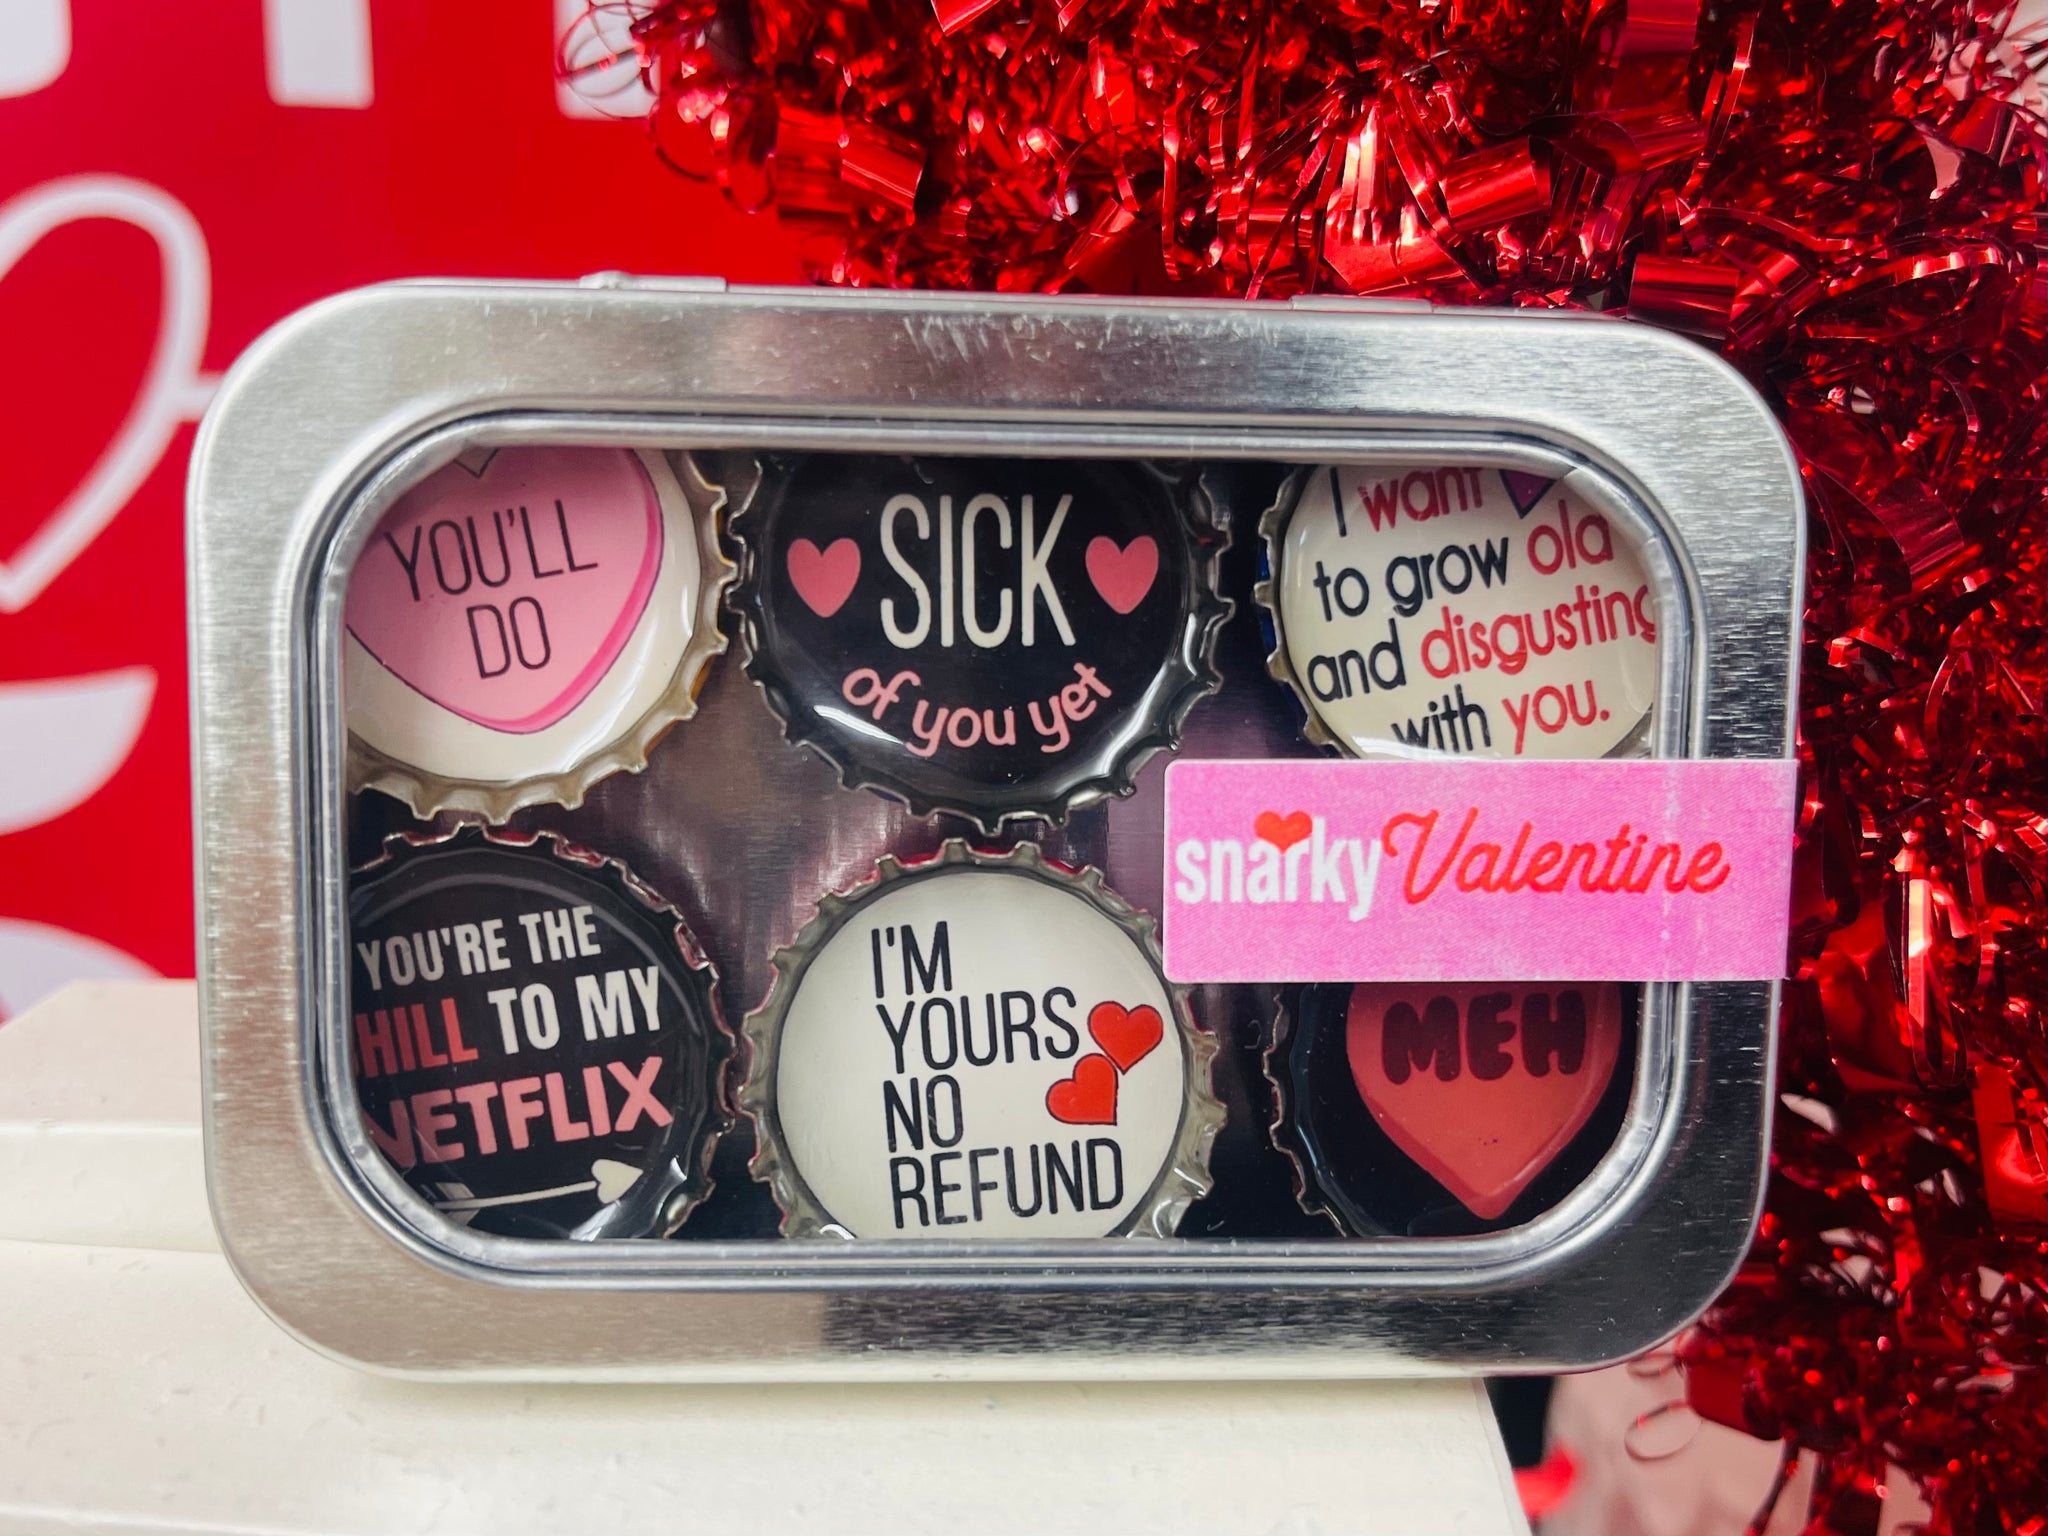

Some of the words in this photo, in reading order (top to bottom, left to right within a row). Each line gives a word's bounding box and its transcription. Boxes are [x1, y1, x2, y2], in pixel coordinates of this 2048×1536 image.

[1330, 467, 1347, 537] I
[384, 500, 598, 601] YOU'LL
[880, 493, 1076, 648] SICK
[1313, 561, 1369, 621] to
[1386, 536, 1509, 617] grow
[467, 597, 551, 678] DO
[1307, 617, 1407, 702] and
[842, 667, 922, 720] of
[904, 700, 1016, 758] you
[1027, 662, 1112, 753] yet
[1391, 684, 1491, 753] with
[1502, 680, 1609, 755] you.
[1175, 815, 1383, 922] snarky
[1382, 807, 1731, 905] Valentine
[357, 919, 511, 990] YOU'RE
[519, 906, 602, 964] THE
[871, 921, 953, 998] I'M
[352, 998, 478, 1078] HILL
[487, 983, 561, 1055] TO
[575, 965, 660, 1042] MY
[876, 986, 1079, 1074] YOURS
[1382, 989, 1586, 1085] MEH
[883, 1074, 964, 1153] NO
[890, 1137, 1124, 1229] REFUND
